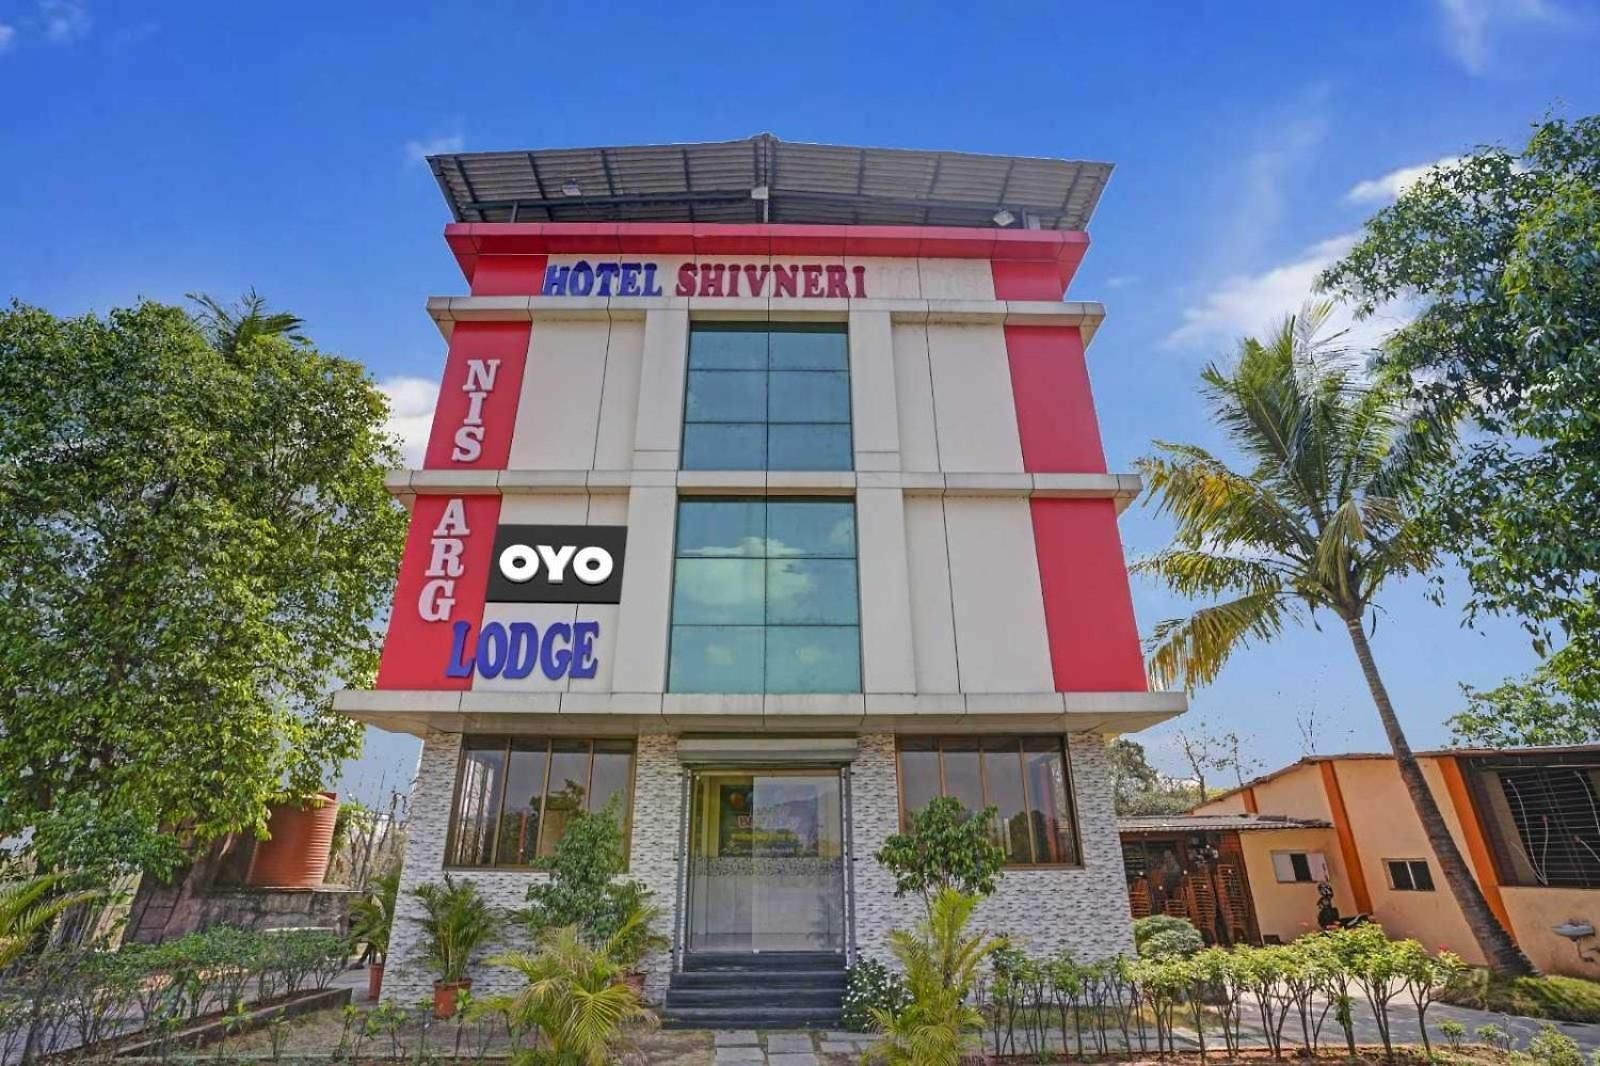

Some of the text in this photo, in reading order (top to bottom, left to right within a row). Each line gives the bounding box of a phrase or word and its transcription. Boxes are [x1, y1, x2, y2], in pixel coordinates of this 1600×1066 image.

[543, 260, 663, 297] HOTEL
[675, 262, 867, 298] SHIVNERI
[499, 544, 613, 585] OYO
[446, 620, 600, 681] LODGE
